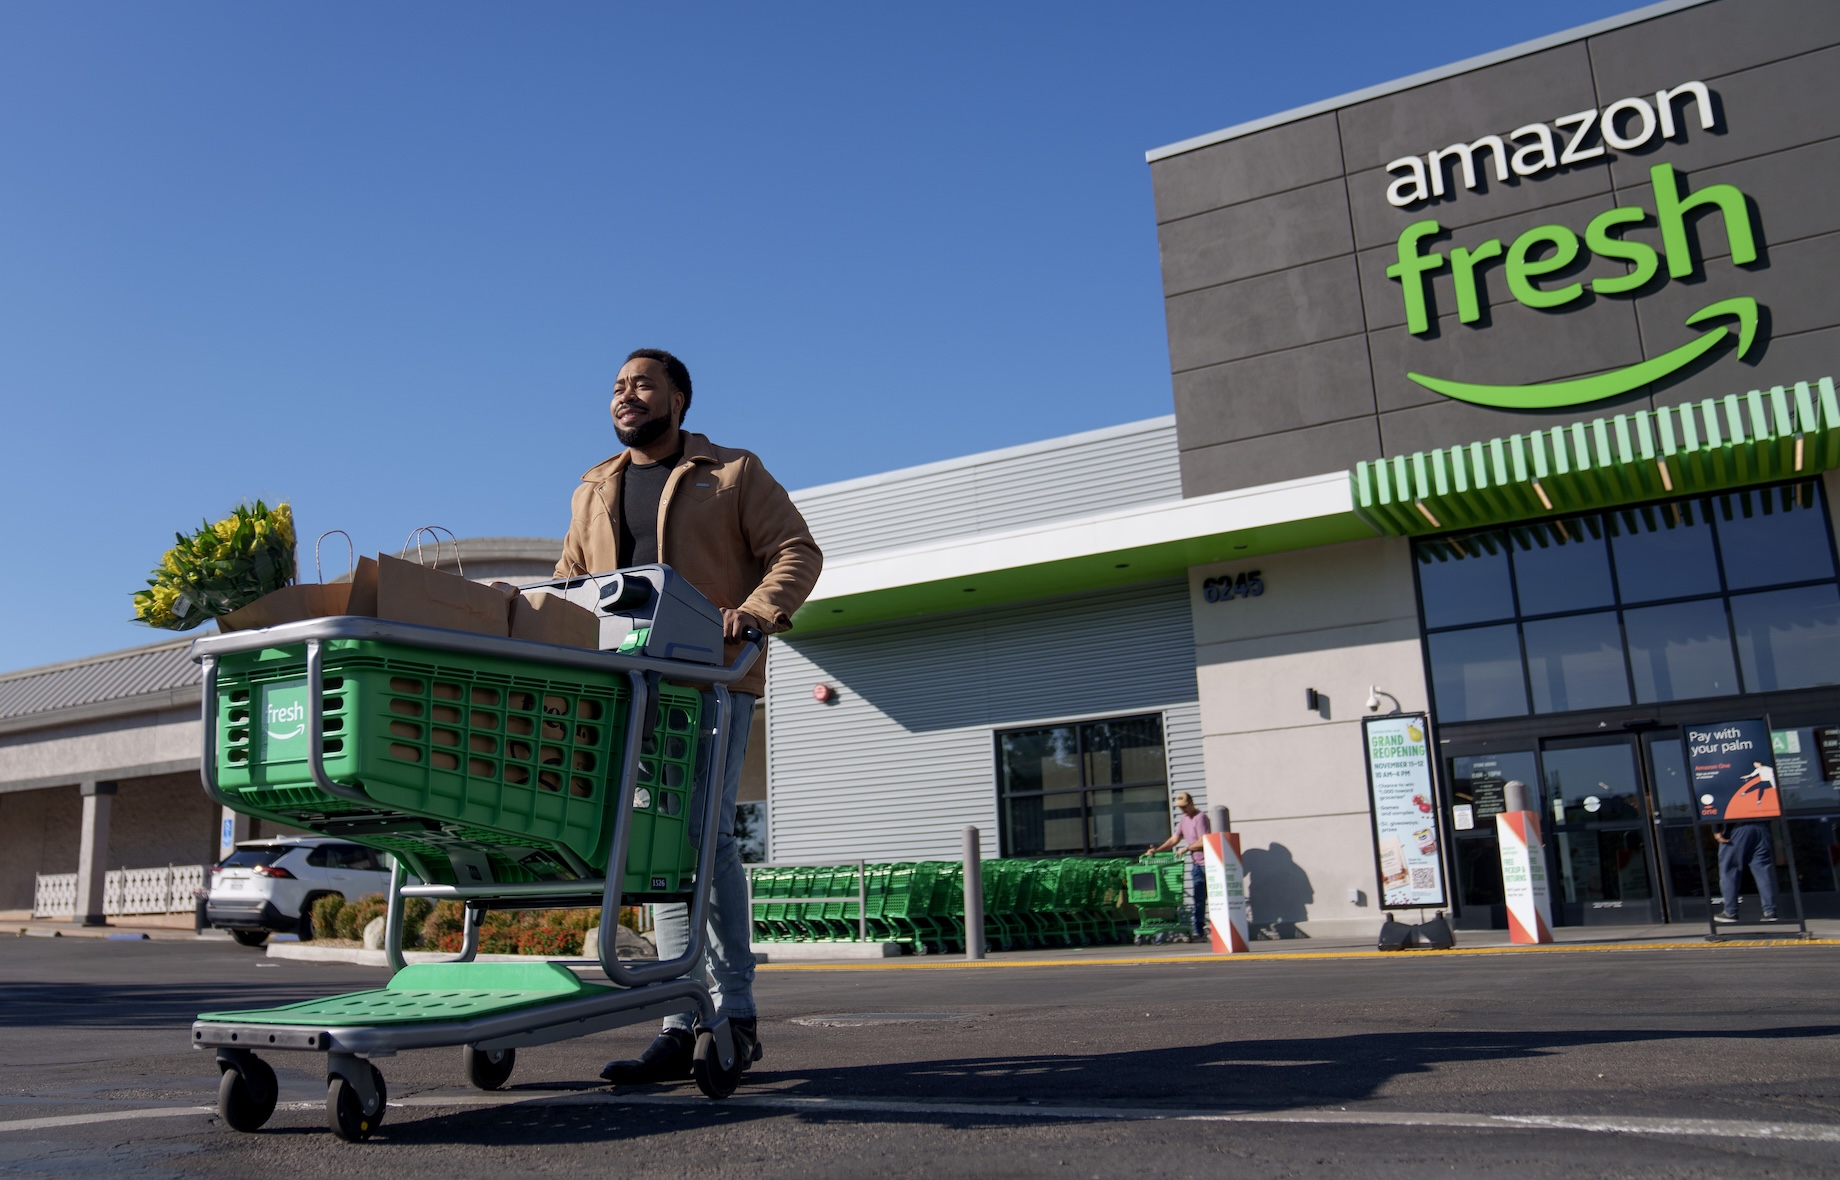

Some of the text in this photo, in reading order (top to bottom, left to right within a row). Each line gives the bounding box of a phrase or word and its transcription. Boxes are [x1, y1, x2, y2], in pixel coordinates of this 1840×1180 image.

[1386, 81, 1714, 206] amazon
[1386, 162, 1757, 334] fresh
[1203, 570, 1264, 603] 6245
[266, 701, 304, 723] fresh
[1372, 735, 1404, 747] GRAND
[1690, 727, 1741, 744] Pay with
[1773, 737, 1785, 750] A
[1373, 745, 1425, 759] REOPENING
[1691, 739, 1753, 757] your palm
[1702, 808, 1717, 816] one
